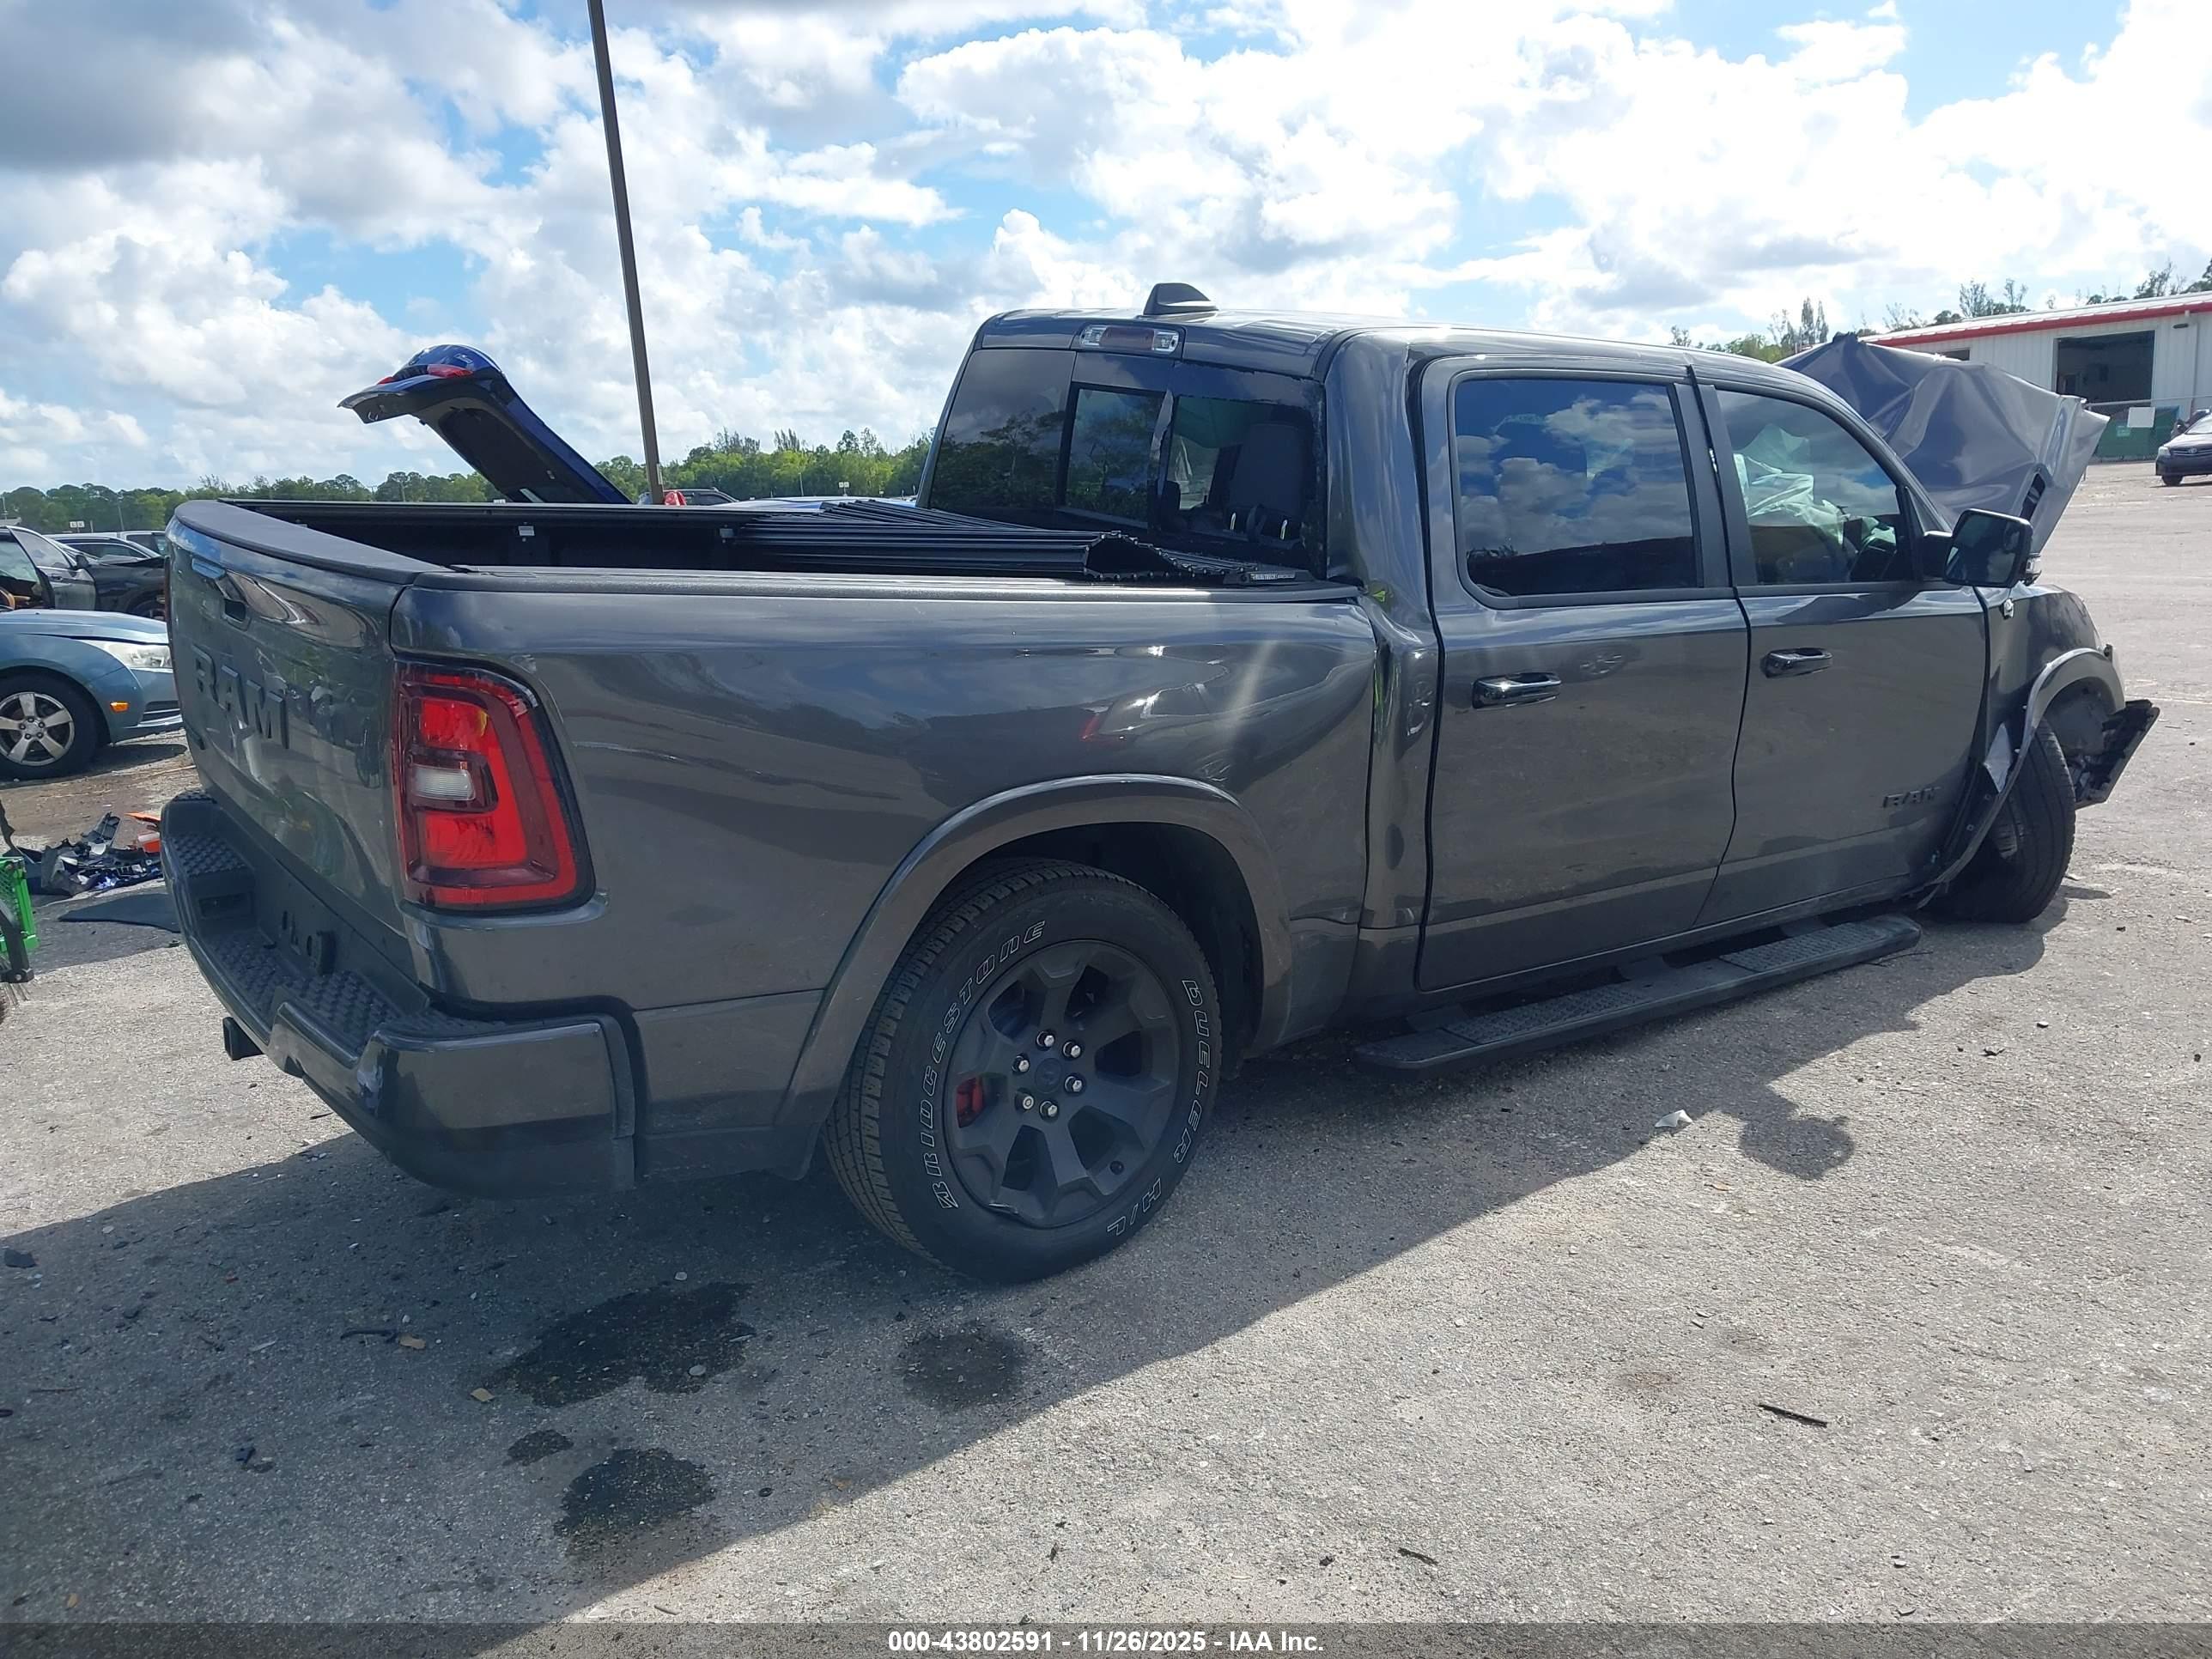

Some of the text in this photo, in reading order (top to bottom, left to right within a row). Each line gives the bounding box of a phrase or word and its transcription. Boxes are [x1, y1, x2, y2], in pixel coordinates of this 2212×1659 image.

[191, 643, 290, 750] RAM
[1882, 786, 1942, 809] RAM
[921, 920, 1046, 1209] BRIDGESTONE
[1106, 979, 1211, 1236] DUELER H/L
